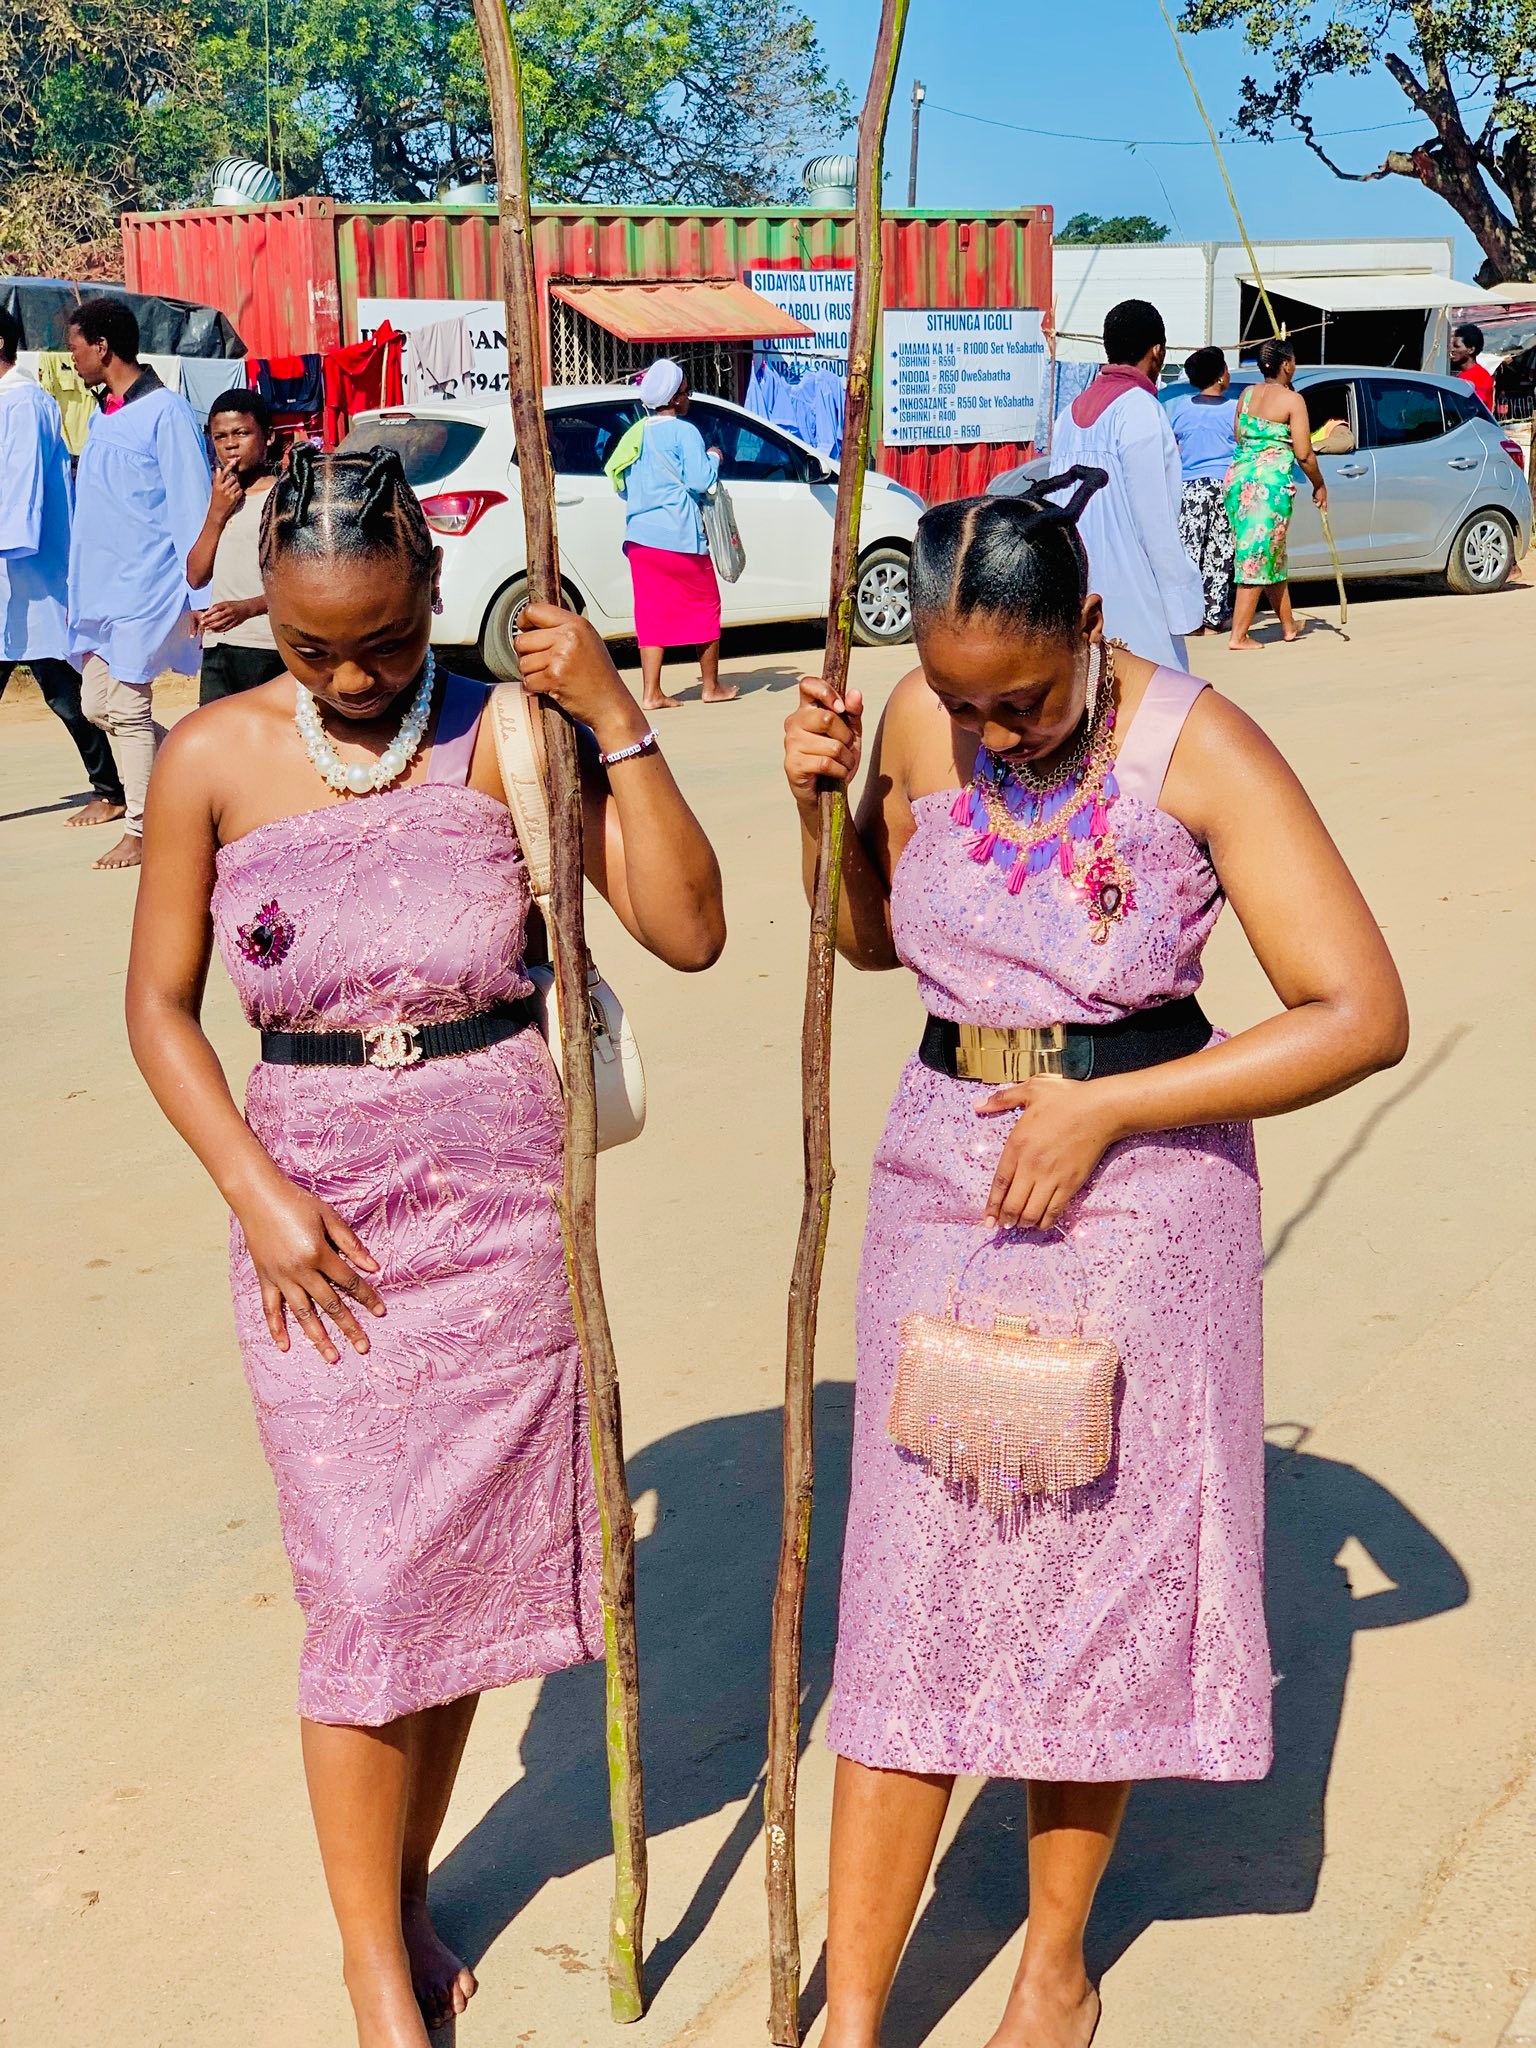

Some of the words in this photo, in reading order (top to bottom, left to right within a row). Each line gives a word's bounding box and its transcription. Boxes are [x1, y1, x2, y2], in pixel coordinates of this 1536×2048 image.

[754, 273, 806, 292] SIDAYISA
[809, 273, 854, 292] UTHAYE
[825, 302, 851, 322] (RUS
[927, 314, 980, 331] SITHUNGA
[983, 313, 1012, 331] IGOLI
[814, 332, 848, 349] INHLO
[898, 342, 930, 356] UMAMA
[932, 342, 943, 355] KA
[946, 342, 954, 355] 14
[963, 342, 988, 355] R1000
[991, 341, 1004, 354] Set
[1006, 341, 1045, 354] YeSabatha
[898, 355, 930, 367] ISBHINKI
[938, 355, 956, 367] R550
[899, 370, 930, 383] INDODA
[939, 369, 959, 382] R650
[961, 369, 1011, 382] OweSabatha
[899, 383, 930, 395] ISBHINKI
[938, 383, 956, 394] R550
[899, 396, 948, 410] INKOSAZANE
[957, 396, 977, 409] R550
[978, 395, 992, 408] Set
[993, 395, 1034, 408] YeSabatha
[899, 411, 931, 422] ISBHINKI
[938, 410, 957, 422] R400
[899, 425, 951, 440] INTETHELELO
[961, 424, 981, 438] R550
